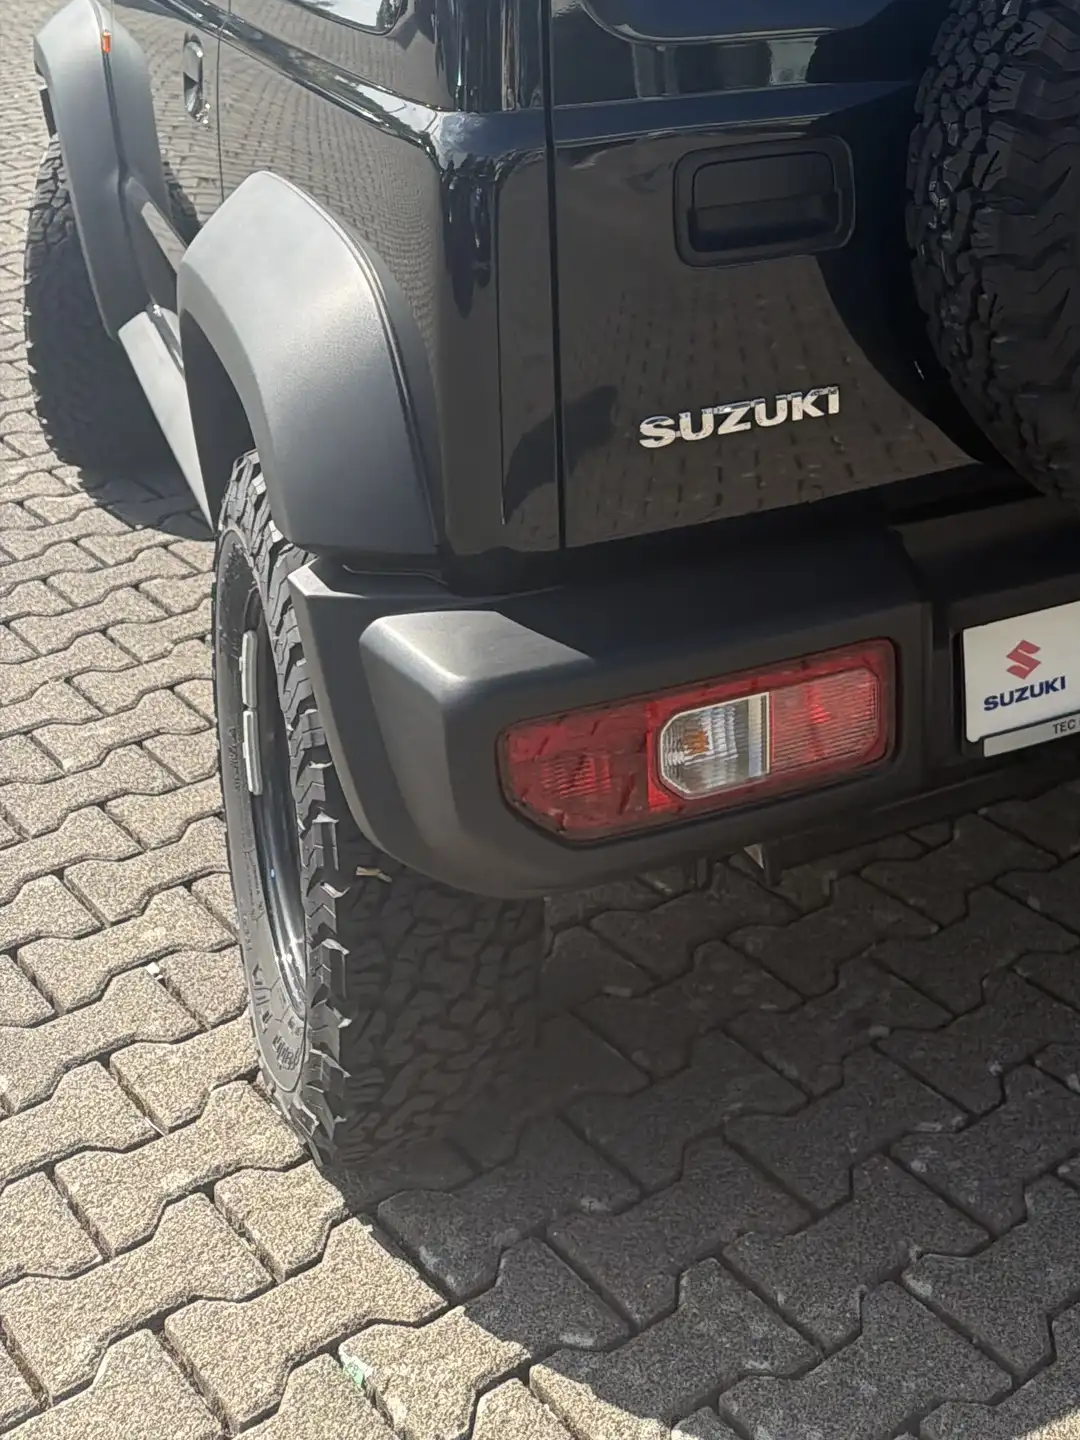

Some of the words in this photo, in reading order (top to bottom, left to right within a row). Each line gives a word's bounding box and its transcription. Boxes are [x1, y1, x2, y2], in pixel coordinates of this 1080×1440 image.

[639, 386, 840, 449] SUZUKI
[983, 674, 1067, 712] SUZUKI
[1052, 717, 1077, 735] TEC
